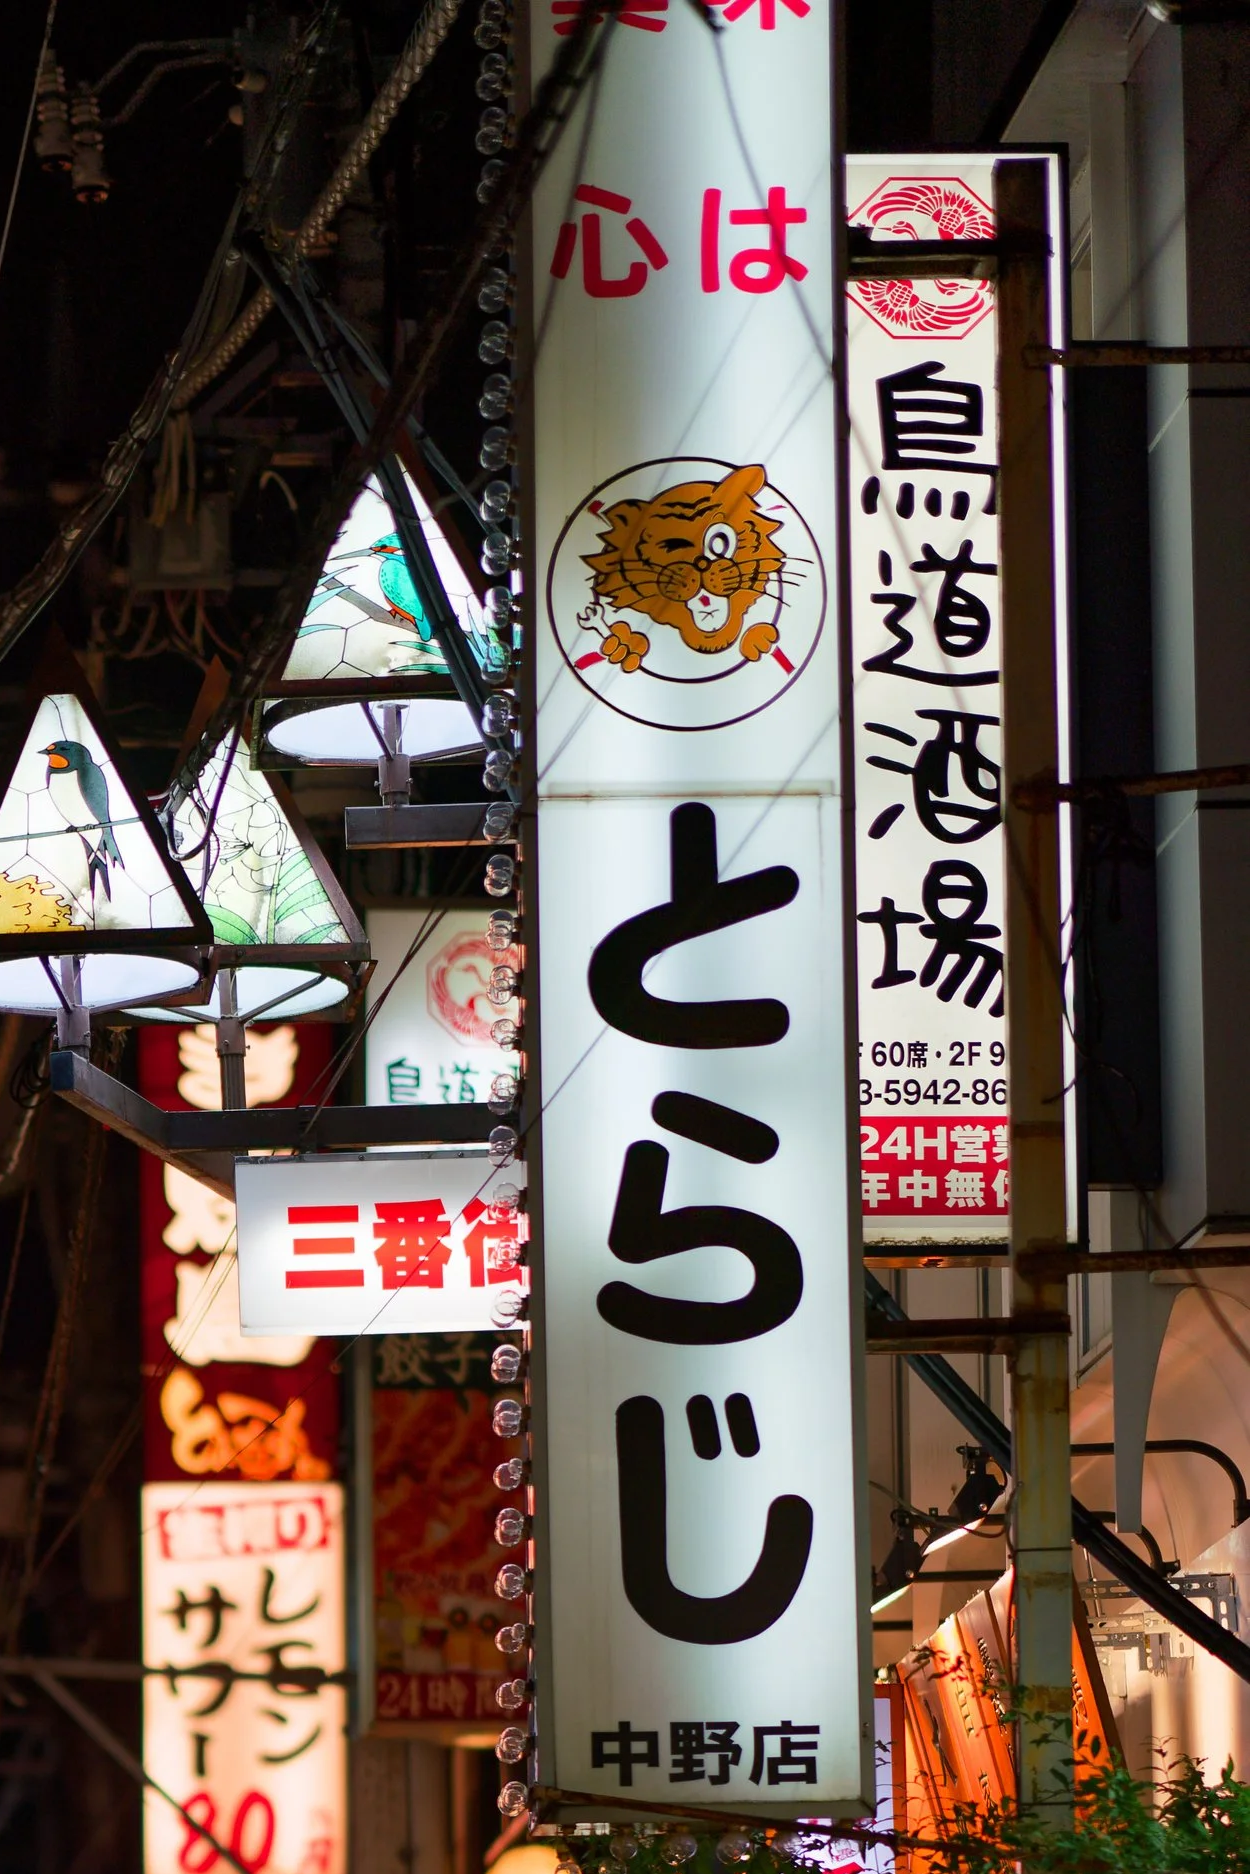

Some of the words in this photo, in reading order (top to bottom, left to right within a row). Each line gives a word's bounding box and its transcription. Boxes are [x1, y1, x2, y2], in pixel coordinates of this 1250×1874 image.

[860, 361, 1001, 1018] 鳥道酒場
[587, 802, 814, 1645] とらじ
[162, 1584, 238, 1780] サワー
[253, 1567, 323, 1765] レモン
[590, 1720, 821, 1788] 中野店
[178, 1790, 275, 1874] 80
